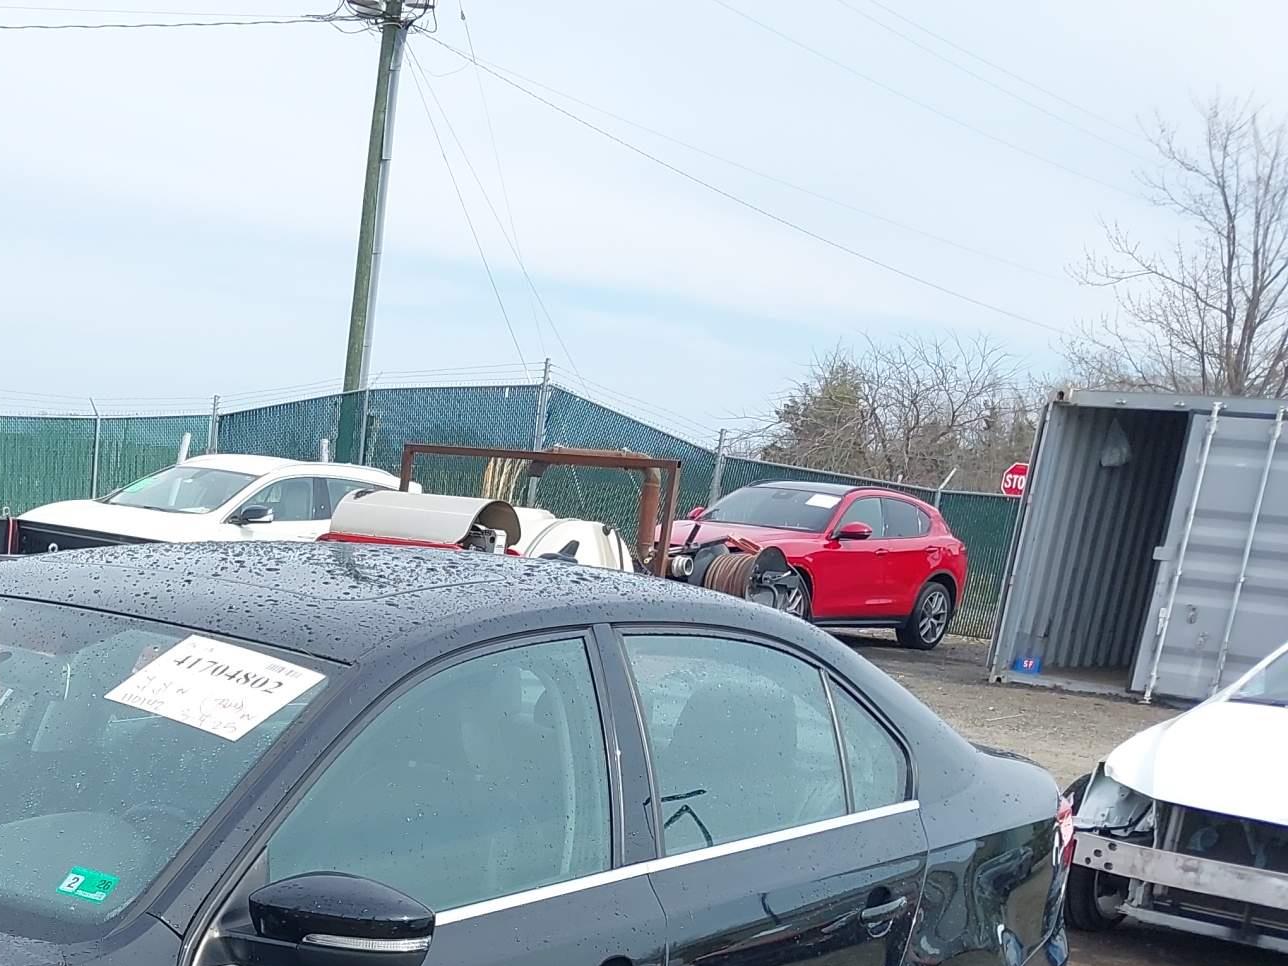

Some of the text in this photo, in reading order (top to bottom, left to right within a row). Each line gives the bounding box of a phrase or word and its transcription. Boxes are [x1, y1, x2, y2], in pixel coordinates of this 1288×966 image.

[1004, 473, 1025, 490] STO
[172, 654, 285, 695] 41704802
[66, 876, 80, 889] 2
